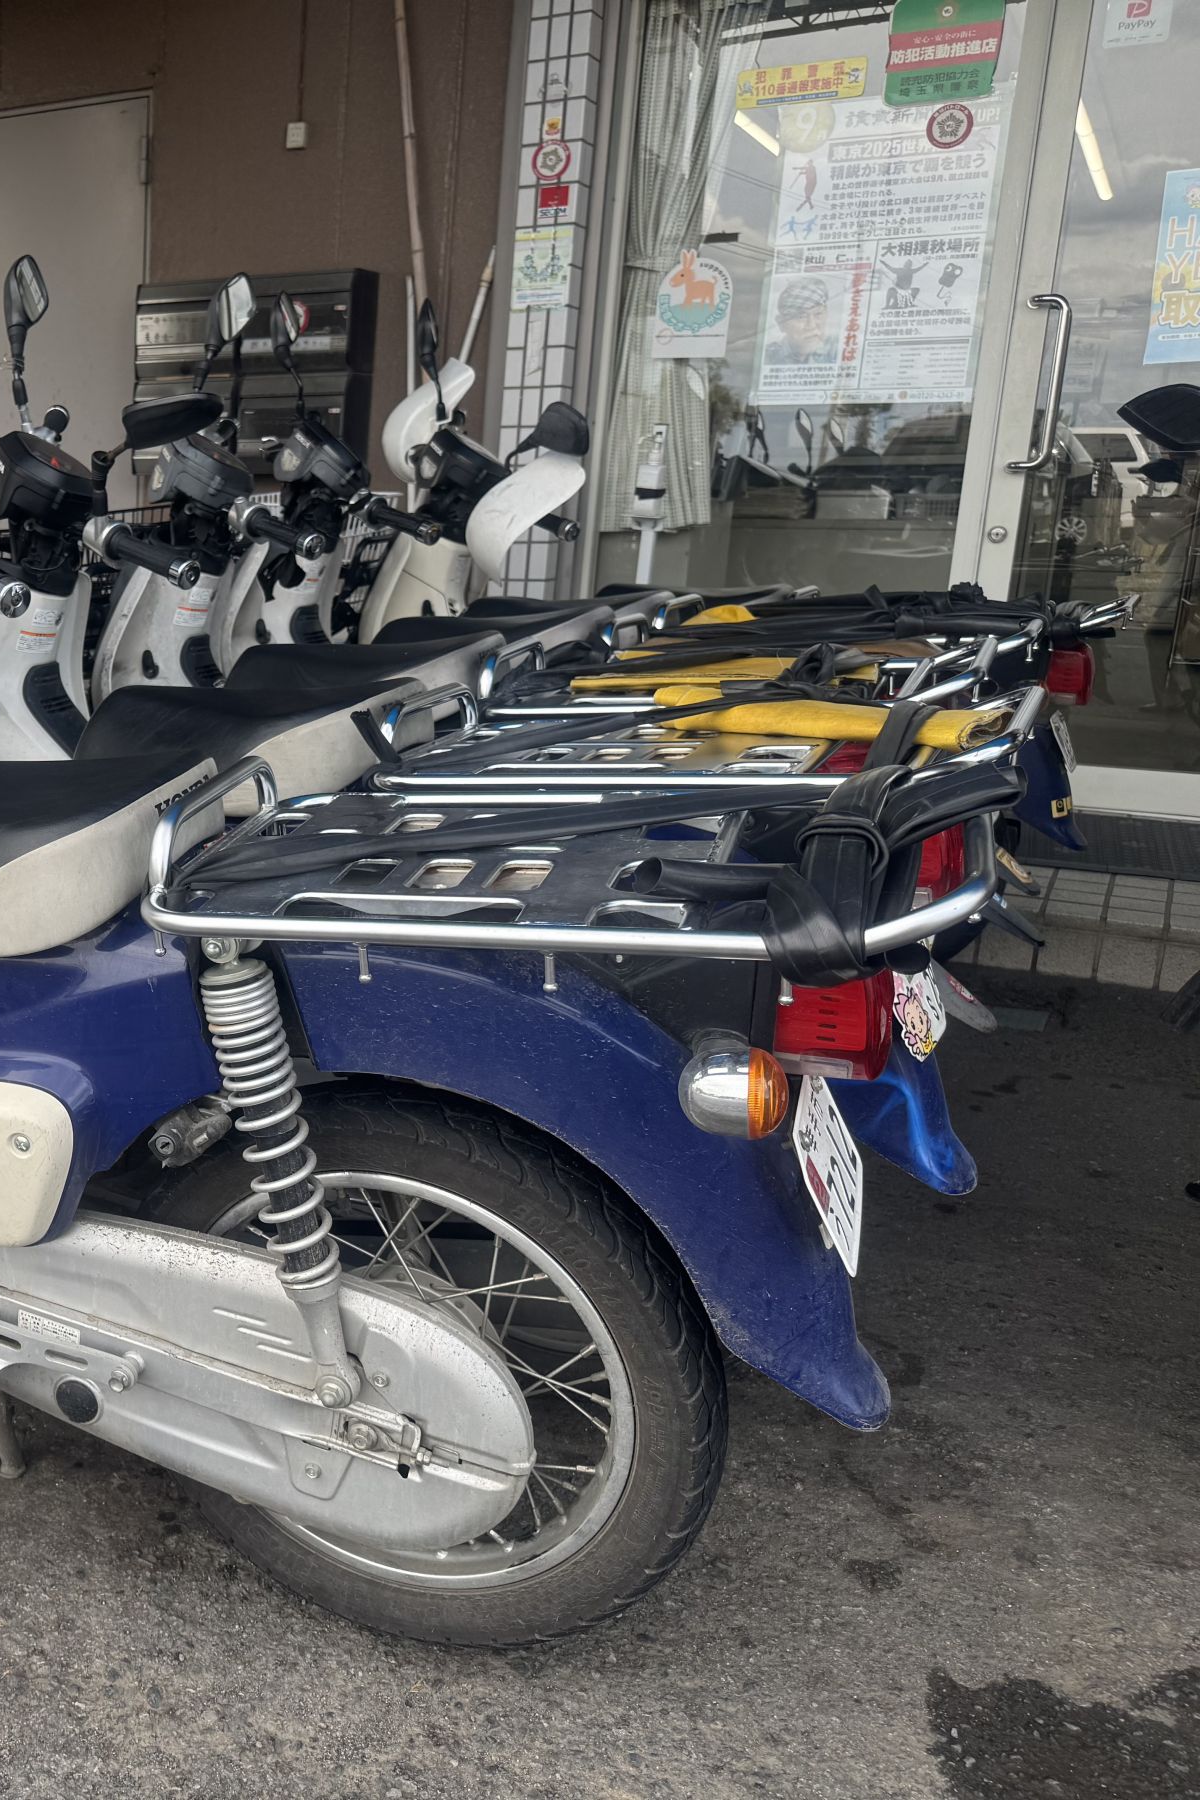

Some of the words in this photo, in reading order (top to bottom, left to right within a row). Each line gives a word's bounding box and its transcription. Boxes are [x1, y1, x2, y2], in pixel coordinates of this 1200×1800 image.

[1118, 20, 1156, 31] PayPay
[889, 38, 997, 65] 防犯活動推進店
[899, 80, 979, 97] 埼玉県警察
[831, 134, 963, 161] 東京2025世界
[1166, 215, 1200, 250] H
[881, 236, 980, 257] 大相撲秋場所
[699, 262, 730, 290] supporter
